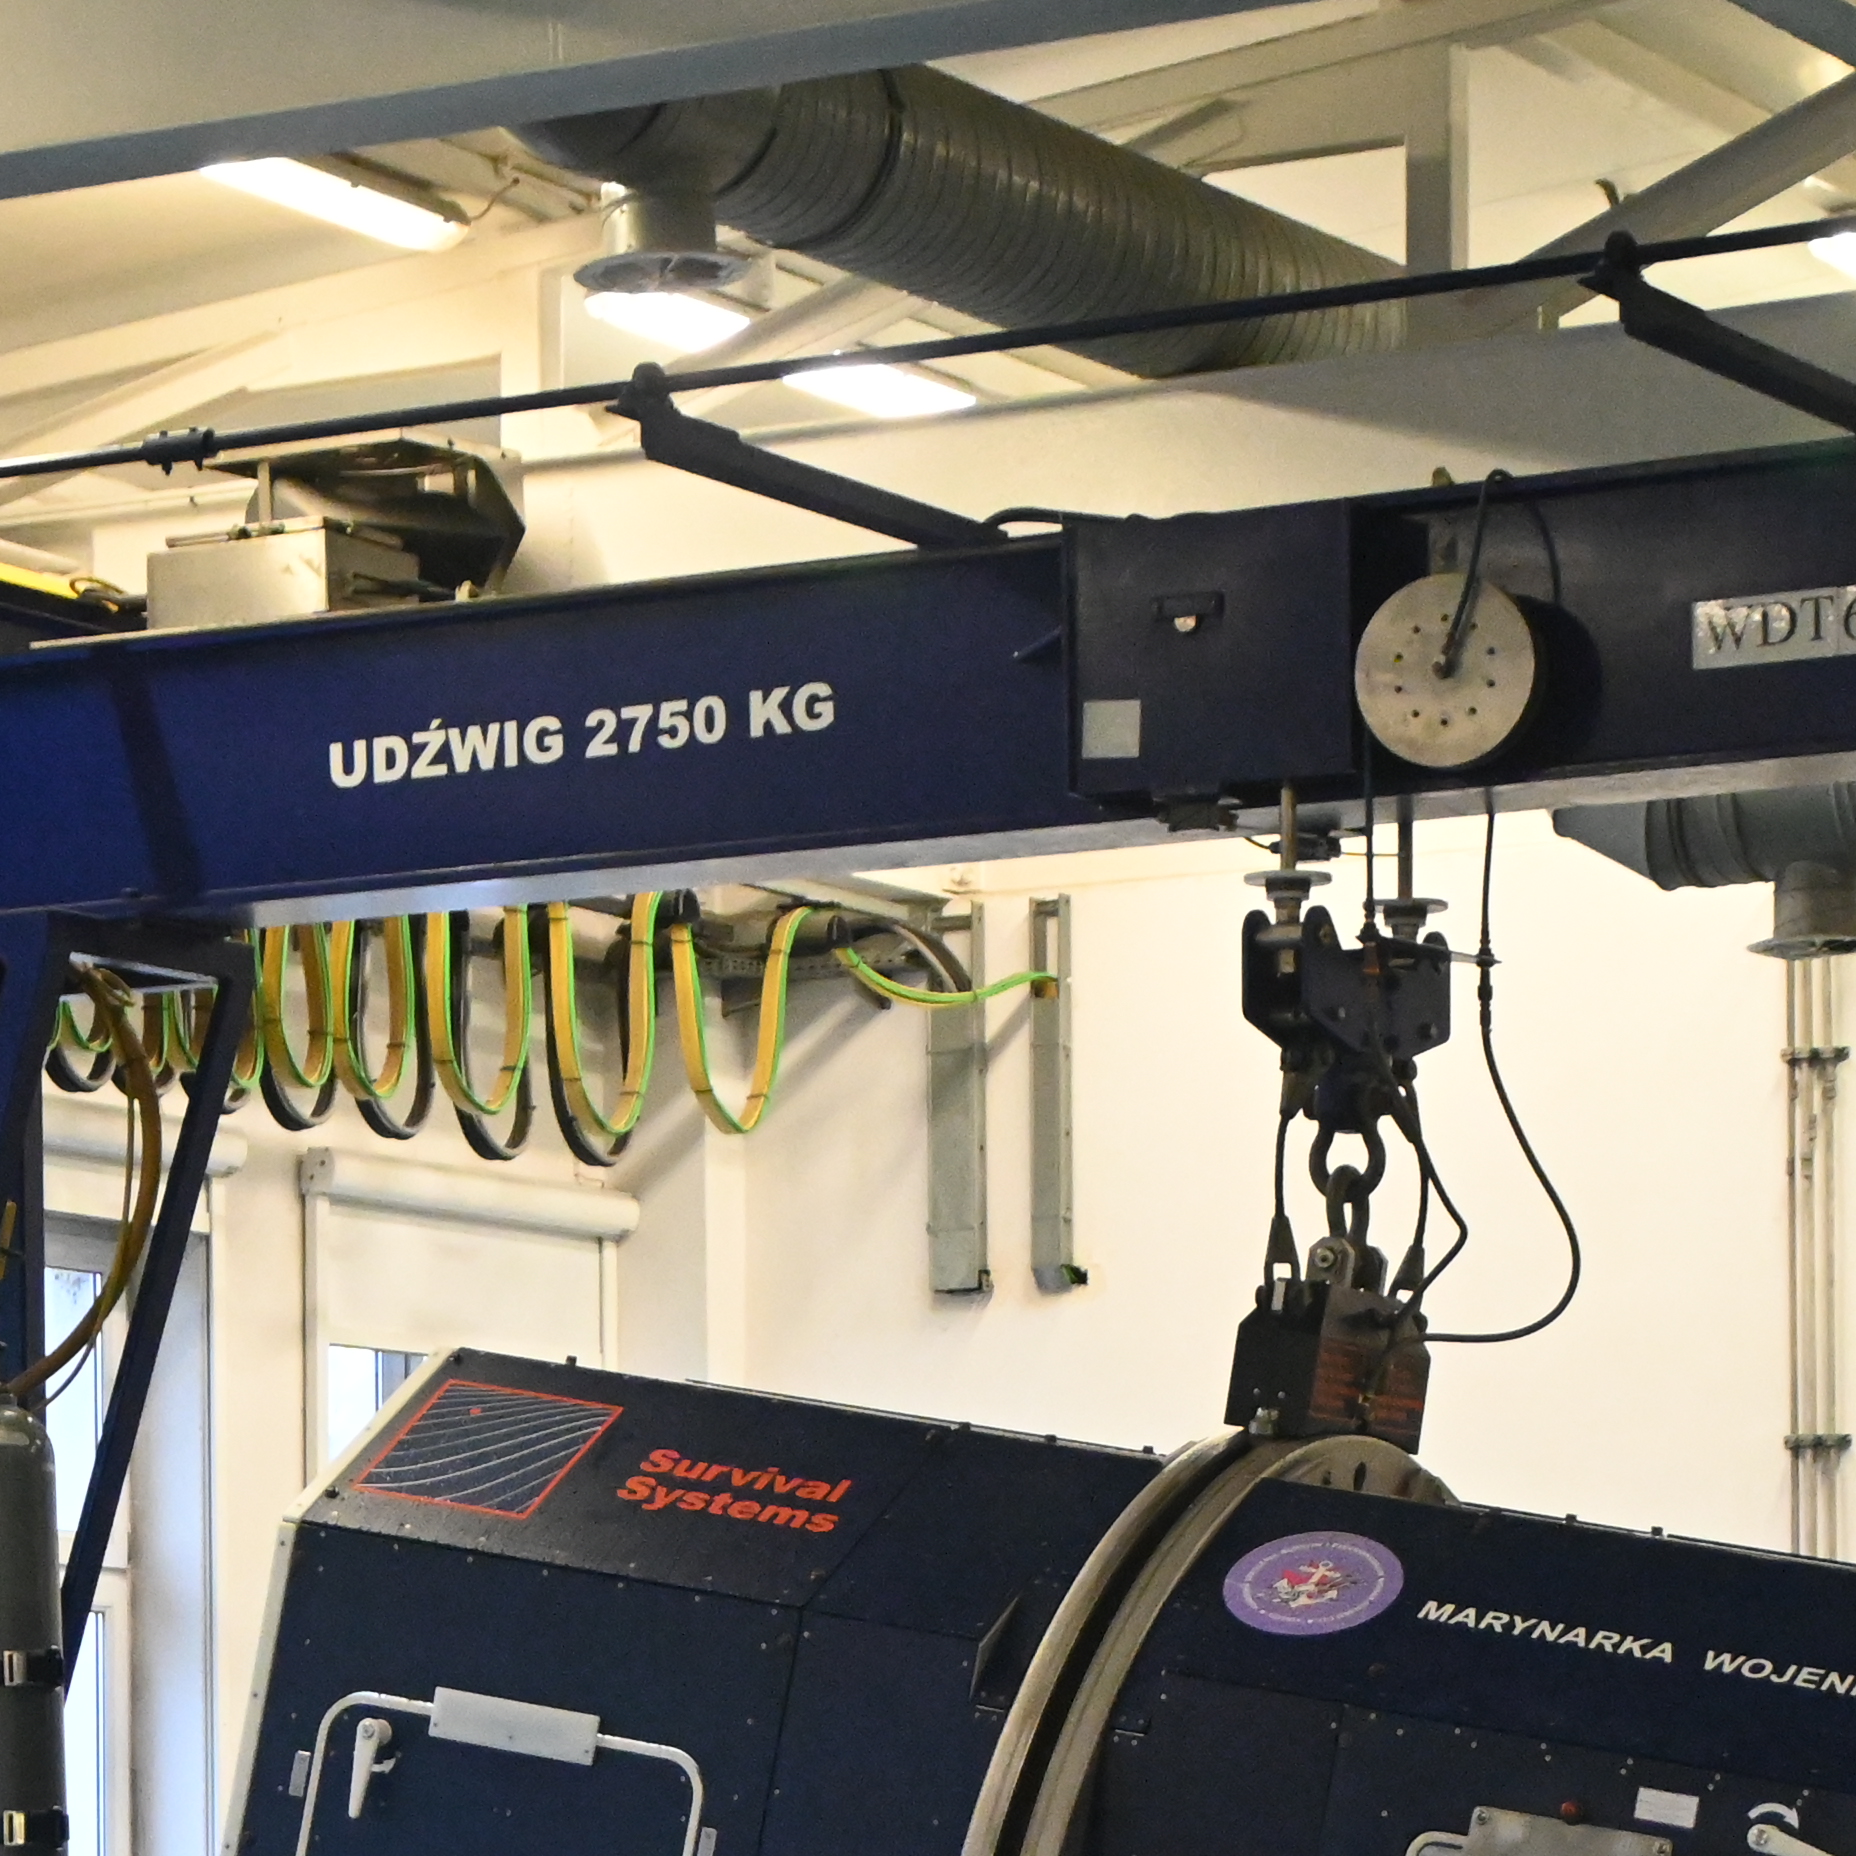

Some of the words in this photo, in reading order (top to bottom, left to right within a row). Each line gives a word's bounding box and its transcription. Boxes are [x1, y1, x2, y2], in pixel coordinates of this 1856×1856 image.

[1703, 593, 1834, 654] WDT
[328, 716, 564, 789] UDŹWIG
[584, 694, 727, 760] 2750
[749, 681, 836, 738] KG
[617, 1474, 839, 1533] Systems
[640, 1449, 851, 1503] Survival
[1417, 1599, 1674, 1664] MARYNARKA
